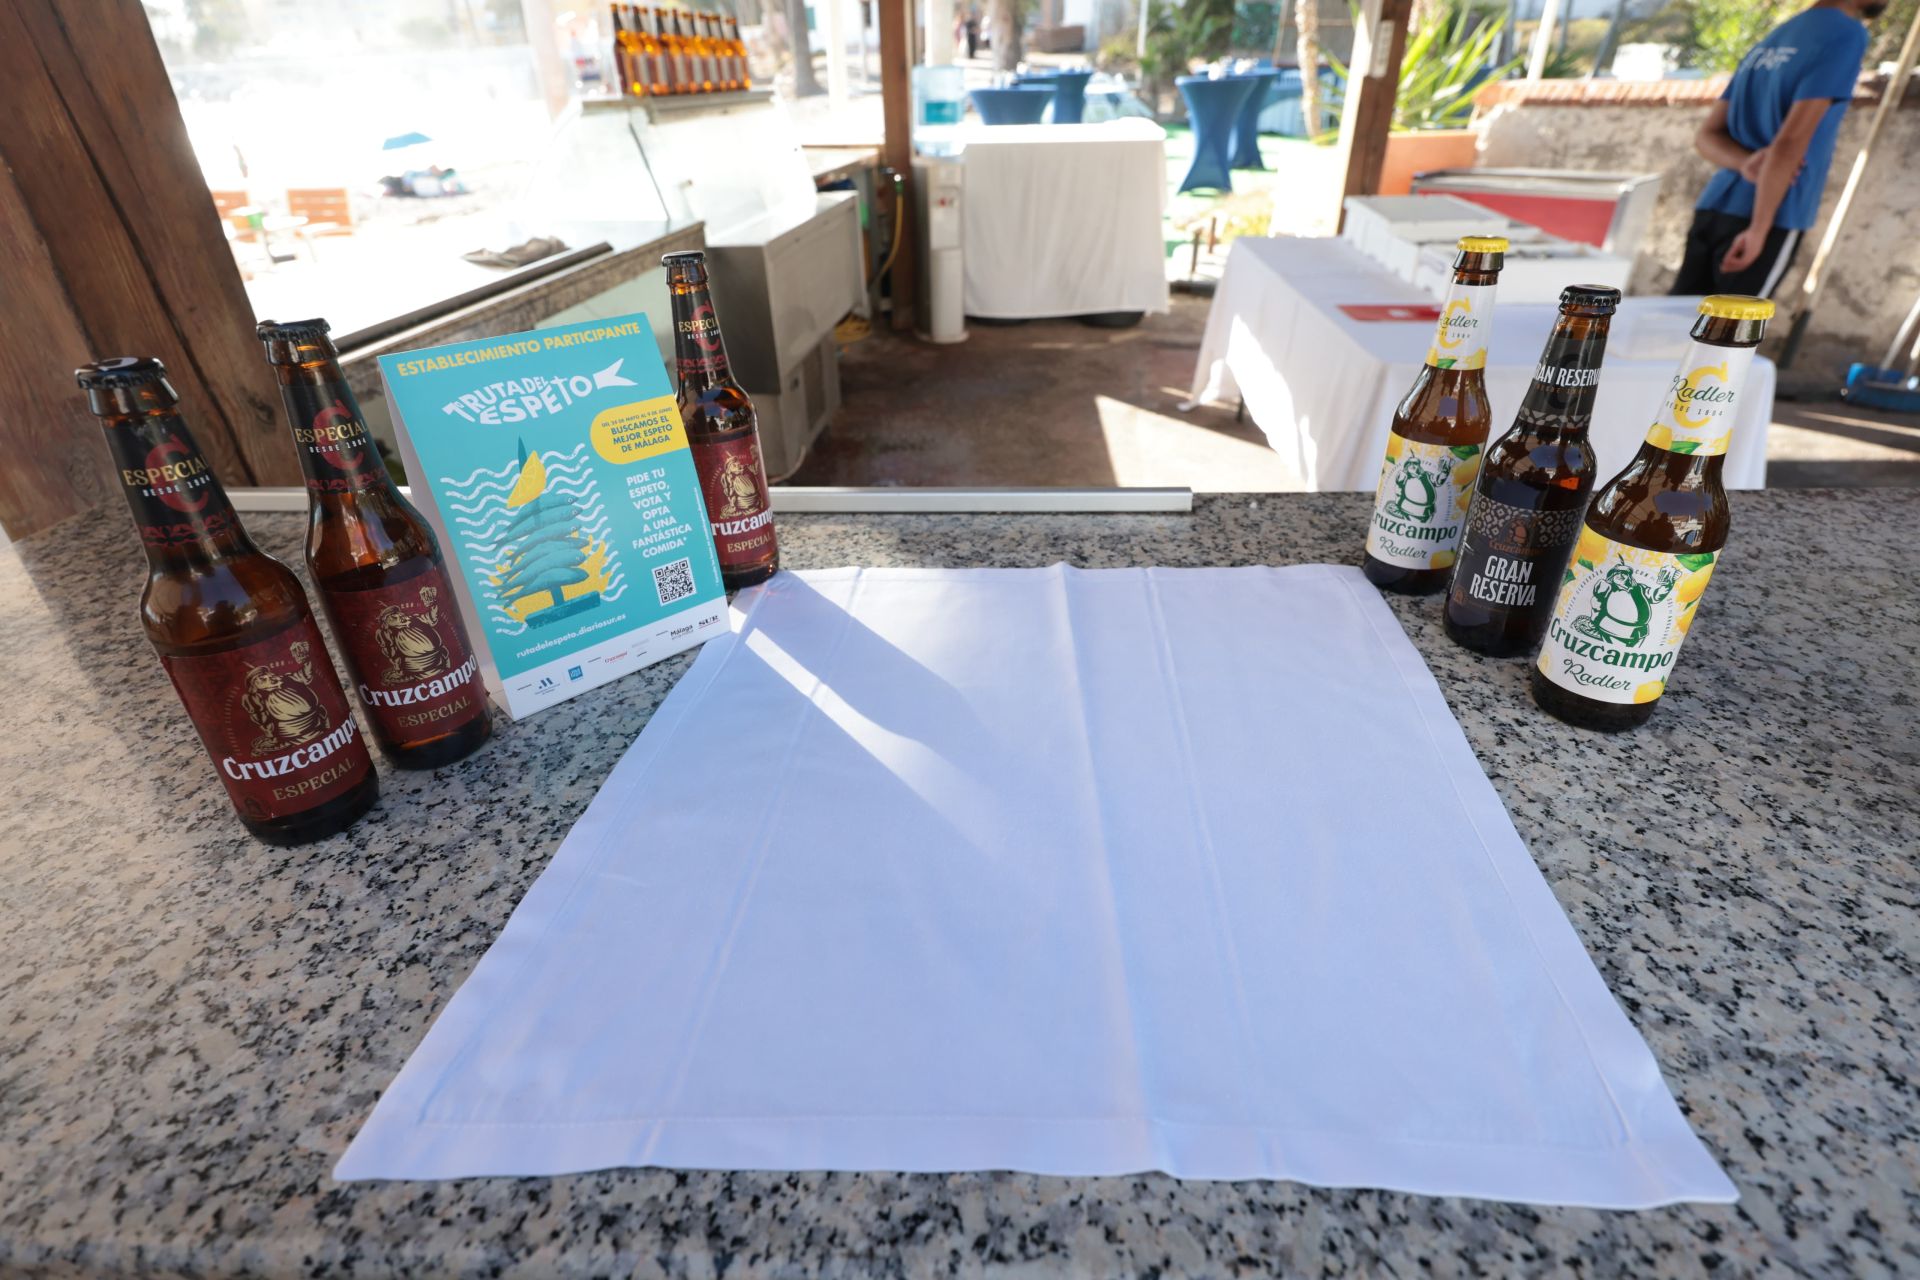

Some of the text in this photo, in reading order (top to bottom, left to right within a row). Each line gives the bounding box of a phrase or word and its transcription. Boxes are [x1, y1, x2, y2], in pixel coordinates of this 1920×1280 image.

[678, 318, 717, 332] ESPECI
[397, 322, 640, 376] ESTABLECIMIENTO PARTICIPANTE
[458, 380, 526, 414] RUTA
[521, 376, 549, 394] DEL
[480, 374, 593, 424] ESPETO
[1670, 375, 1735, 403] Radler
[295, 419, 367, 443] ESPECIAL
[611, 415, 670, 435] BUSCAMOS EL
[612, 423, 673, 445] MEJOR ESPETO
[621, 433, 671, 453] DE MÁLAGA
[626, 467, 666, 486] PIDE TU
[628, 480, 670, 499] ESPETO,
[143, 484, 180, 497] DESDE
[632, 491, 672, 510] VOTA Y
[642, 505, 670, 520] OPTA
[642, 515, 677, 534] A UNA
[710, 507, 773, 537] ruzcamp
[631, 523, 693, 550] FANTÁSTICA
[1374, 511, 1458, 543] ruzcampo
[727, 533, 771, 553] ESPECIAL
[1380, 536, 1427, 559] Radler
[1484, 555, 1534, 583] GRAN
[1469, 573, 1537, 606] RESERVA
[516, 613, 627, 659] rutadelespeto.diariosur.es
[670, 624, 693, 637] Málaga
[1550, 617, 1673, 673] Cruzcampo
[358, 652, 477, 707] Cruzcampo
[1563, 657, 1631, 691] Radler
[398, 696, 470, 728] ESPECIAL
[223, 711, 359, 780] Cruzcampo
[272, 758, 356, 801] ESPECIAL
